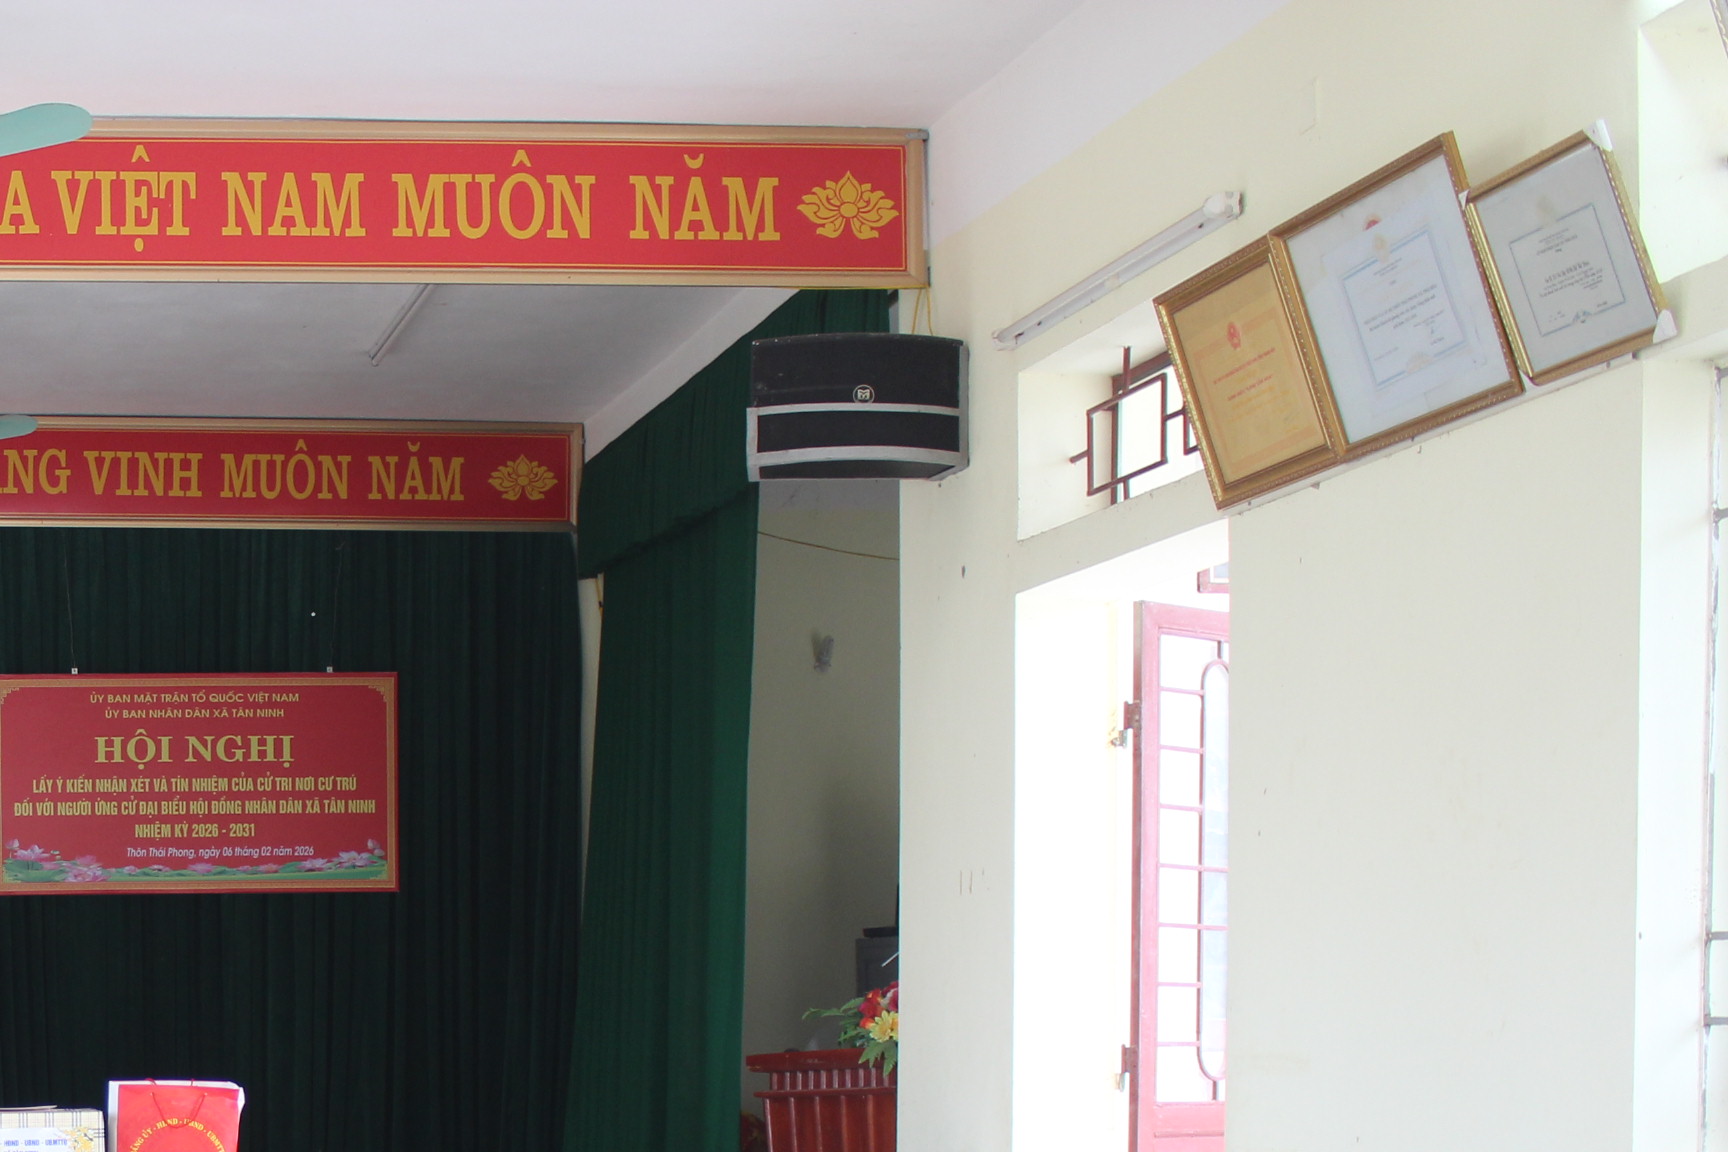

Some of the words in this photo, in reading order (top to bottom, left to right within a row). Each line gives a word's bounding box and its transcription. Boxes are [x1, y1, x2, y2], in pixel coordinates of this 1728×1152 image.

[50, 144, 196, 253] VIỆT
[220, 172, 365, 238] NAM
[390, 149, 596, 240] MUÔN
[628, 155, 781, 242] NĂM
[83, 450, 203, 498] VINH
[219, 438, 356, 500] MUÔN
[367, 440, 465, 502] NĂM
[107, 693, 131, 704] BAN
[209, 690, 245, 704] QUỐC
[247, 691, 270, 705] VIỆT
[272, 693, 300, 703] NAM
[122, 709, 147, 718] BAN
[149, 707, 182, 719] NHÂN
[185, 706, 210, 718] DÂN
[232, 707, 254, 718] TÂN
[256, 708, 285, 718] NINH
[93, 728, 174, 770] HỘI
[184, 734, 295, 769] NGHỊ
[32, 774, 53, 794] LẤY
[66, 774, 93, 793] KIẾN
[95, 775, 128, 796] NHẬN
[130, 776, 151, 793] XÉT
[153, 775, 169, 793] VÀ
[171, 775, 189, 792] TÍN
[191, 774, 229, 795] NHIỆM
[231, 771, 255, 792] CỦA
[257, 771, 274, 792] CỬ
[275, 776, 293, 792] TRI
[295, 776, 315, 791] NƠI
[317, 775, 335, 791] CƯ
[336, 774, 357, 791] TRÚ
[13, 797, 33, 817] ĐỐI
[36, 797, 55, 816] VỚI
[57, 797, 92, 817] NGƯỜI
[94, 797, 119, 816] ỨNG
[121, 796, 138, 816] CỬ
[139, 801, 158, 818] ĐẠI
[161, 795, 186, 815] BIỂU
[189, 797, 208, 818] HỘI
[244, 797, 277, 814] NHÂN
[279, 797, 303, 814] DÂN
[305, 797, 321, 814] XÃ
[323, 797, 345, 813] TÂN
[347, 799, 376, 814] NINH
[134, 821, 172, 841] NHIỆM
[191, 823, 220, 838] 2026
[229, 823, 256, 838] 2031
[126, 846, 147, 858] Thôn
[198, 846, 221, 860] ngày
[221, 846, 234, 858] 06
[234, 845, 260, 860] tháng
[260, 846, 273, 857] 02
[294, 846, 315, 857] 2026
